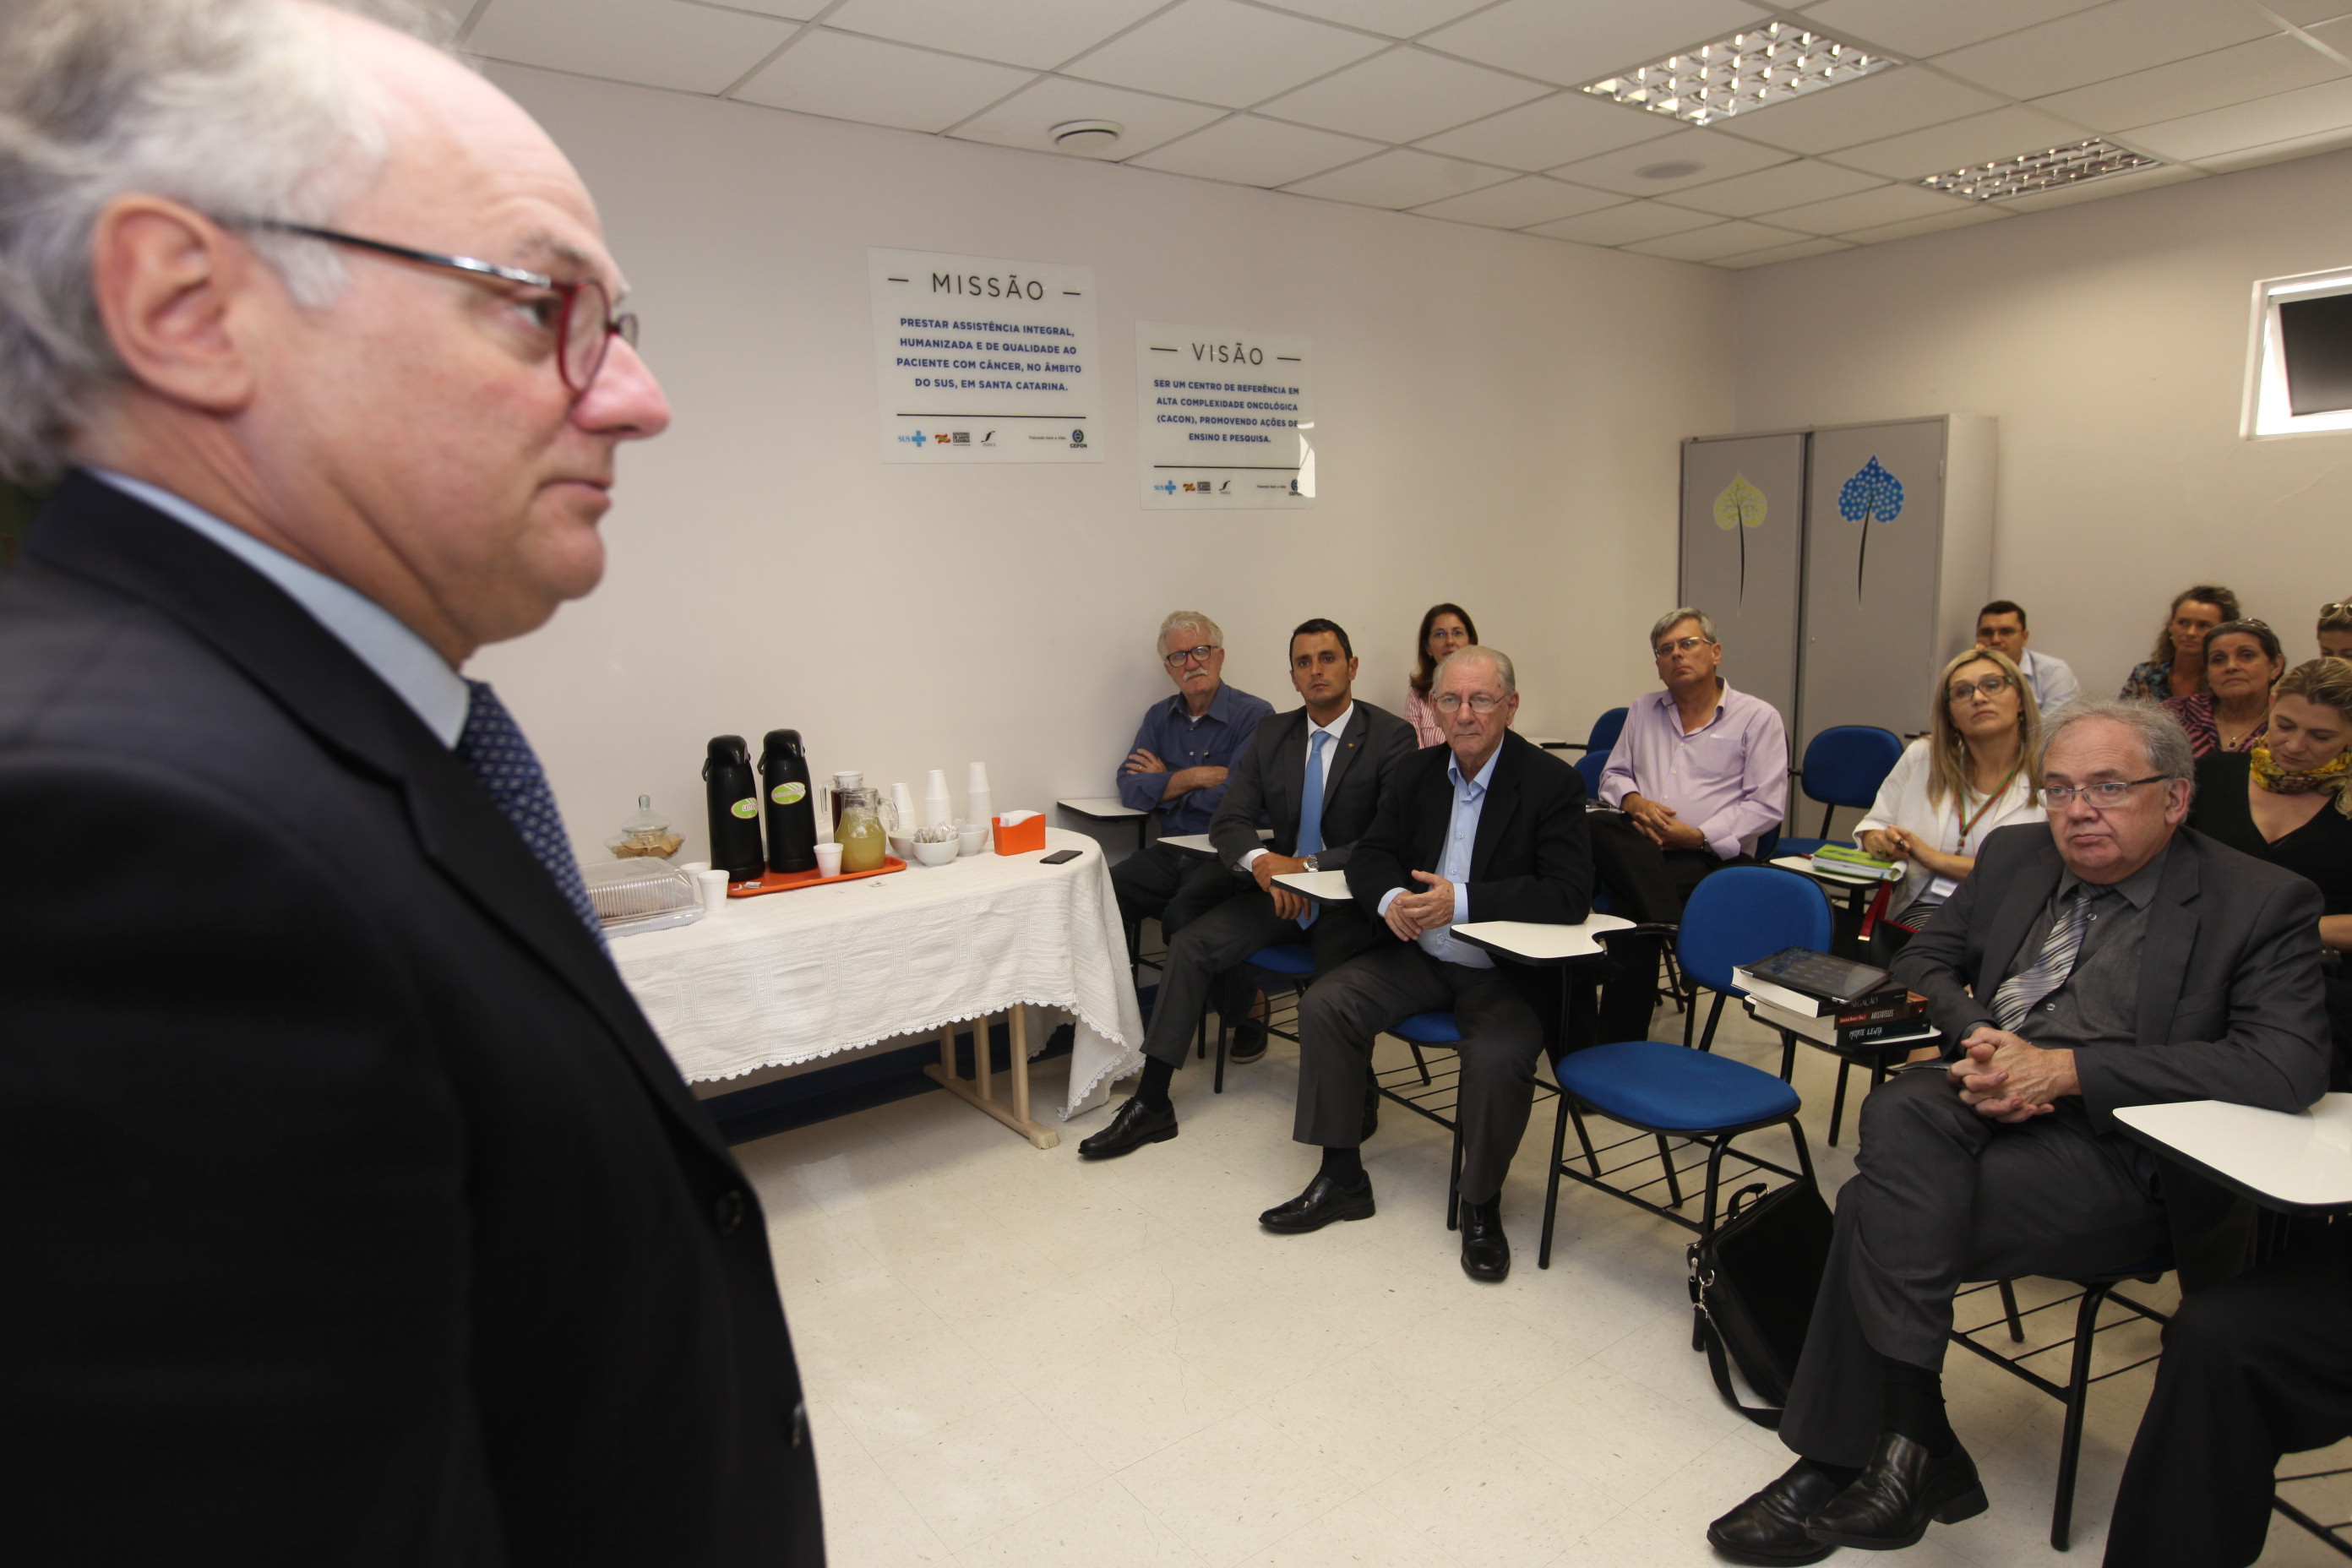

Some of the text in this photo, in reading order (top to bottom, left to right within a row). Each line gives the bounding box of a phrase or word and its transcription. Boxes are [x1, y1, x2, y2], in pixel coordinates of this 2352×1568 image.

[933, 272, 1044, 301] MISSÃO
[901, 318, 1075, 337] PRESTAR ASSISTÊNCIA INTEGRAL,
[900, 338, 1076, 355] HUMANIZADA E DE QUALIDADE AO
[1192, 343, 1263, 365] VISÃO
[896, 358, 1081, 373] PACIENTE COM CÂNCER, NO ÂMBITO
[915, 378, 1068, 390] DO SUS, EM SANTA CATARINA.
[1189, 382, 1222, 390] CENTRO
[1238, 384, 1285, 394] REFERÊNCIA
[1157, 397, 1298, 411] ALTA COMPLEXIDADE ONCOLÓGICA
[1157, 415, 1197, 425] (CACON),
[1200, 416, 1257, 426] PROMOVENDO
[1260, 417, 1286, 427] AÇÕES
